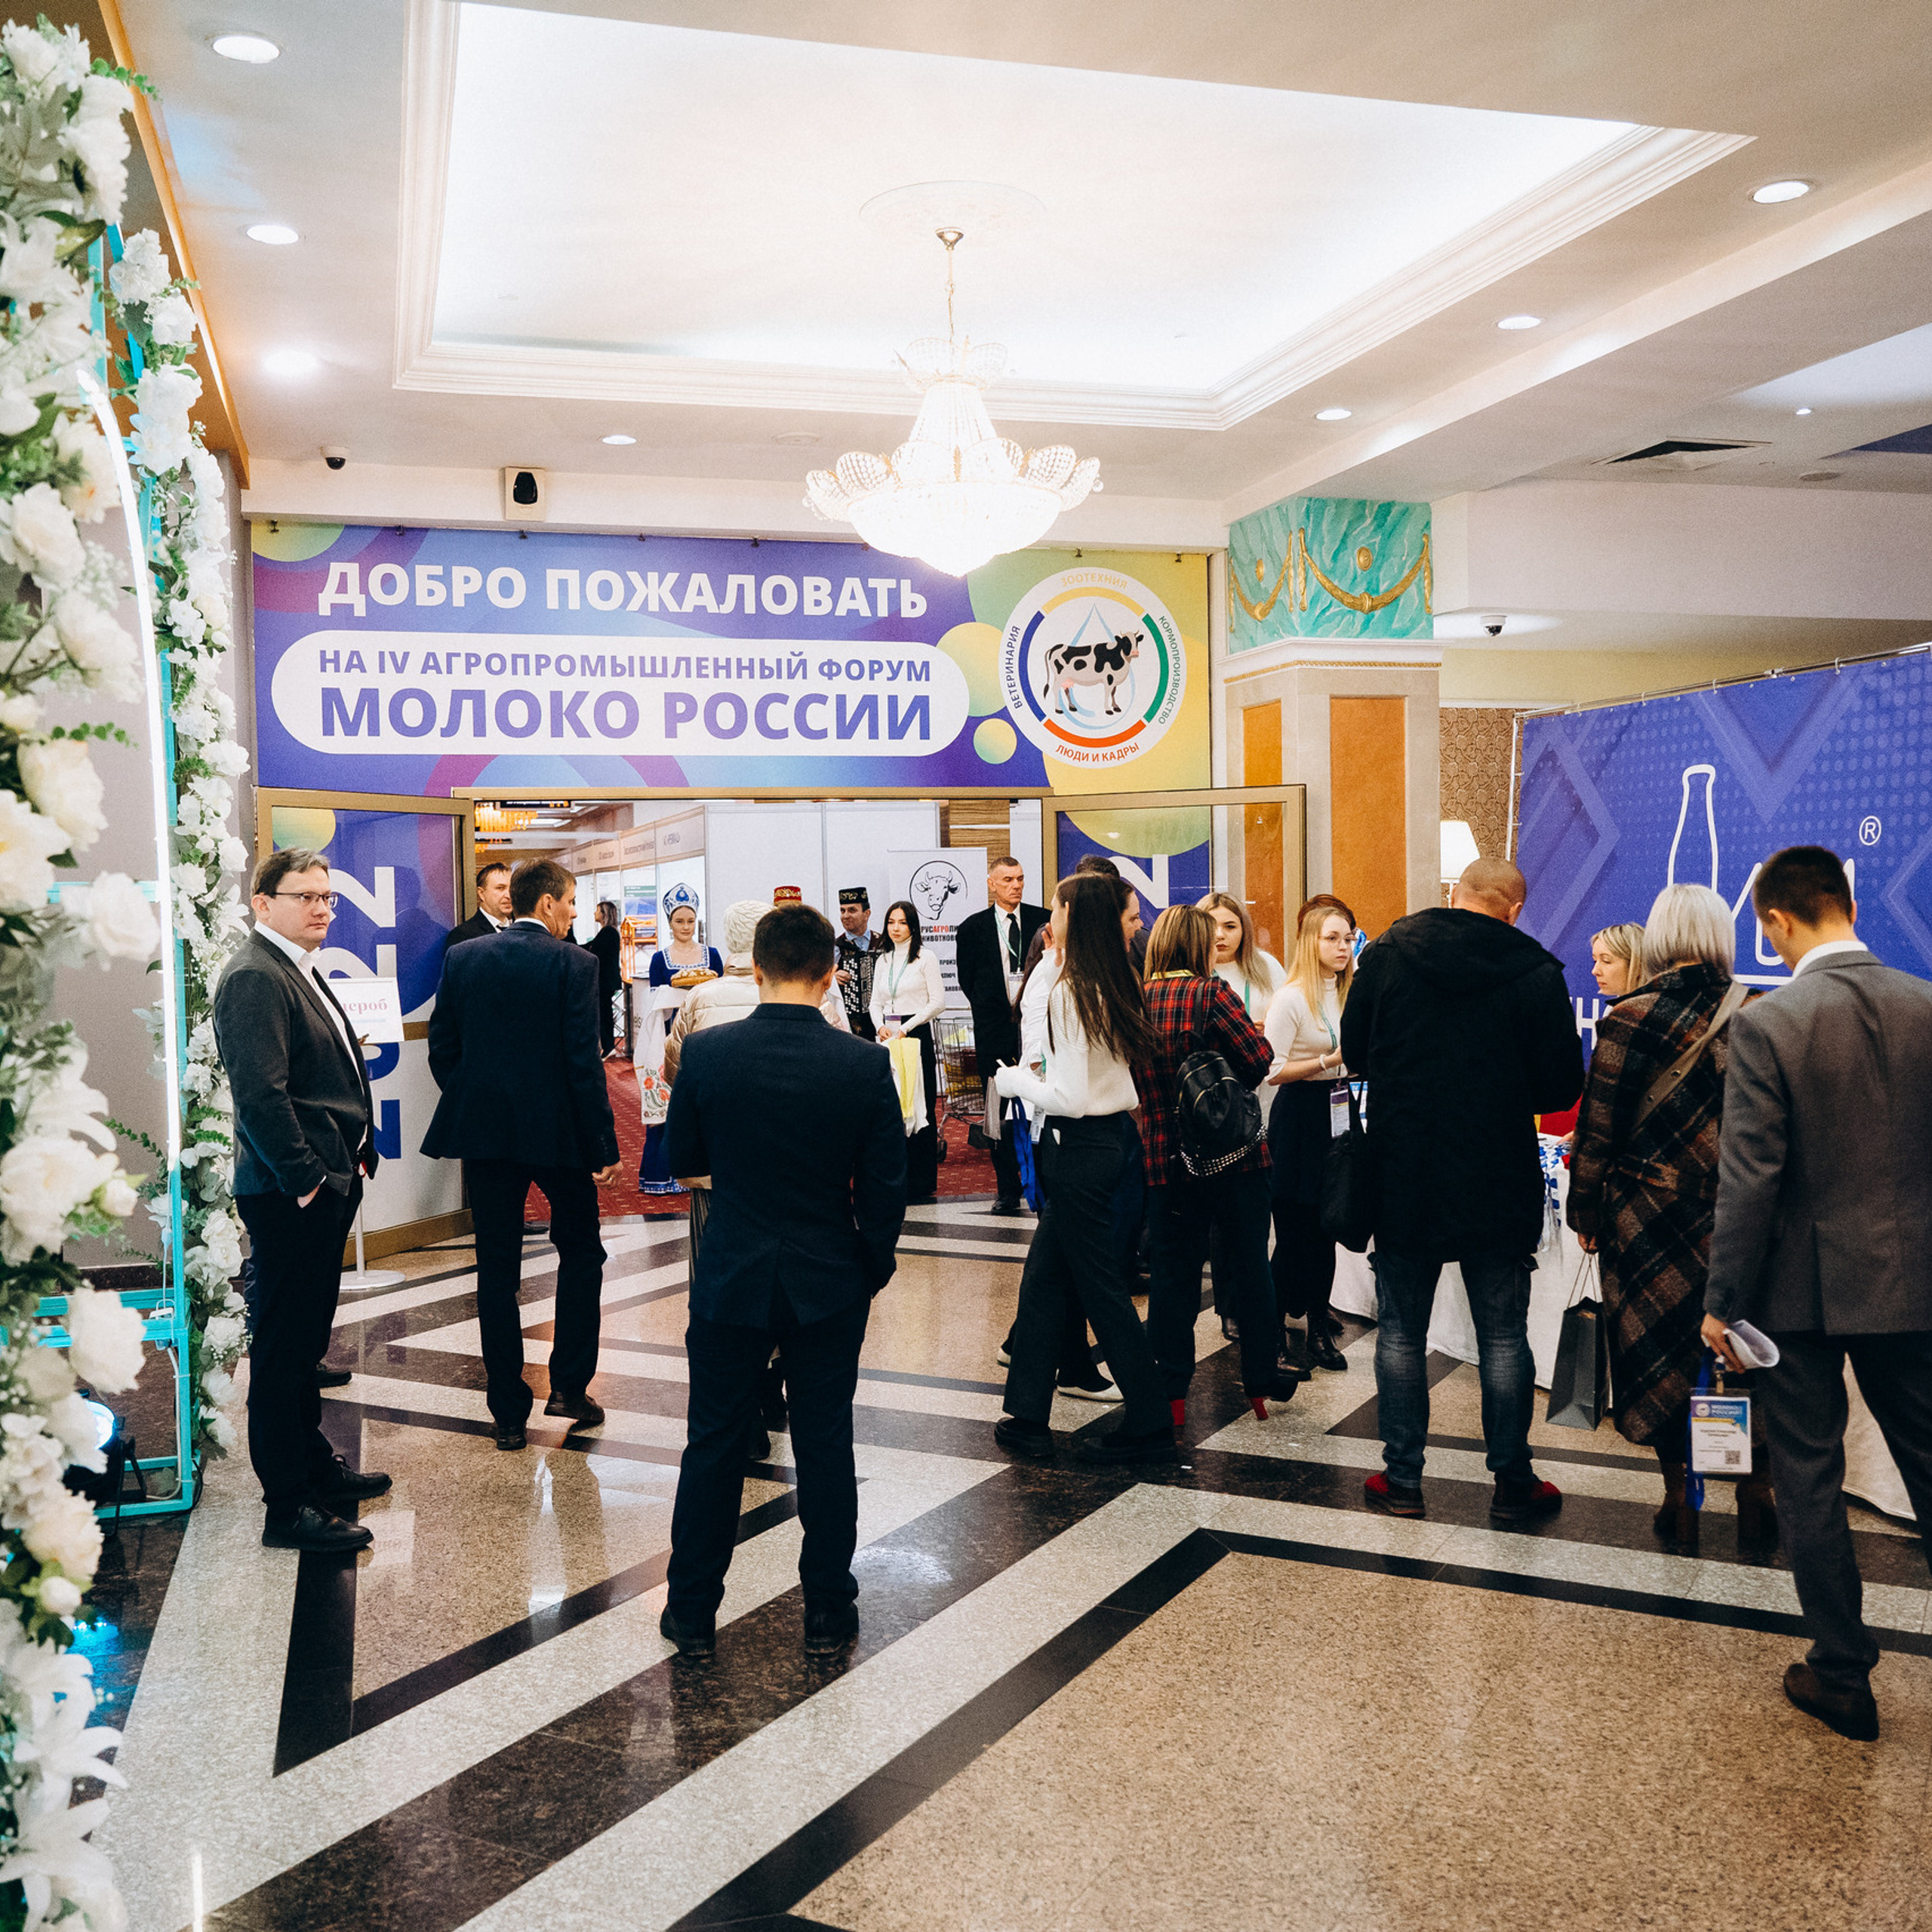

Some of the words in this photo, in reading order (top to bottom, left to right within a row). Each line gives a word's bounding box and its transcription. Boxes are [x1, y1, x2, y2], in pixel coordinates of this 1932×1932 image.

[318, 561, 527, 617] ДОБРО
[545, 568, 928, 617] ПОЖАЛОВАТЬ
[1060, 572, 1128, 589] ЗООТЕХНИЯ
[318, 649, 367, 674] НА
[378, 651, 411, 675] IV
[420, 651, 808, 680] АГРОПРОМЫШЛЕННЫЙ
[818, 659, 931, 682] ФОРУМ
[1005, 626, 1023, 709] ВЕТЕРИНАРИЯ
[1158, 615, 1180, 724] КОРМОПРОИЗВОДСТВО
[321, 686, 641, 739] МОЛОКО
[663, 691, 931, 740] РОССИИ
[1056, 743, 1090, 762] ЛЮДИ
[1091, 752, 1100, 762] И
[1102, 742, 1140, 762] КАДРЫ
